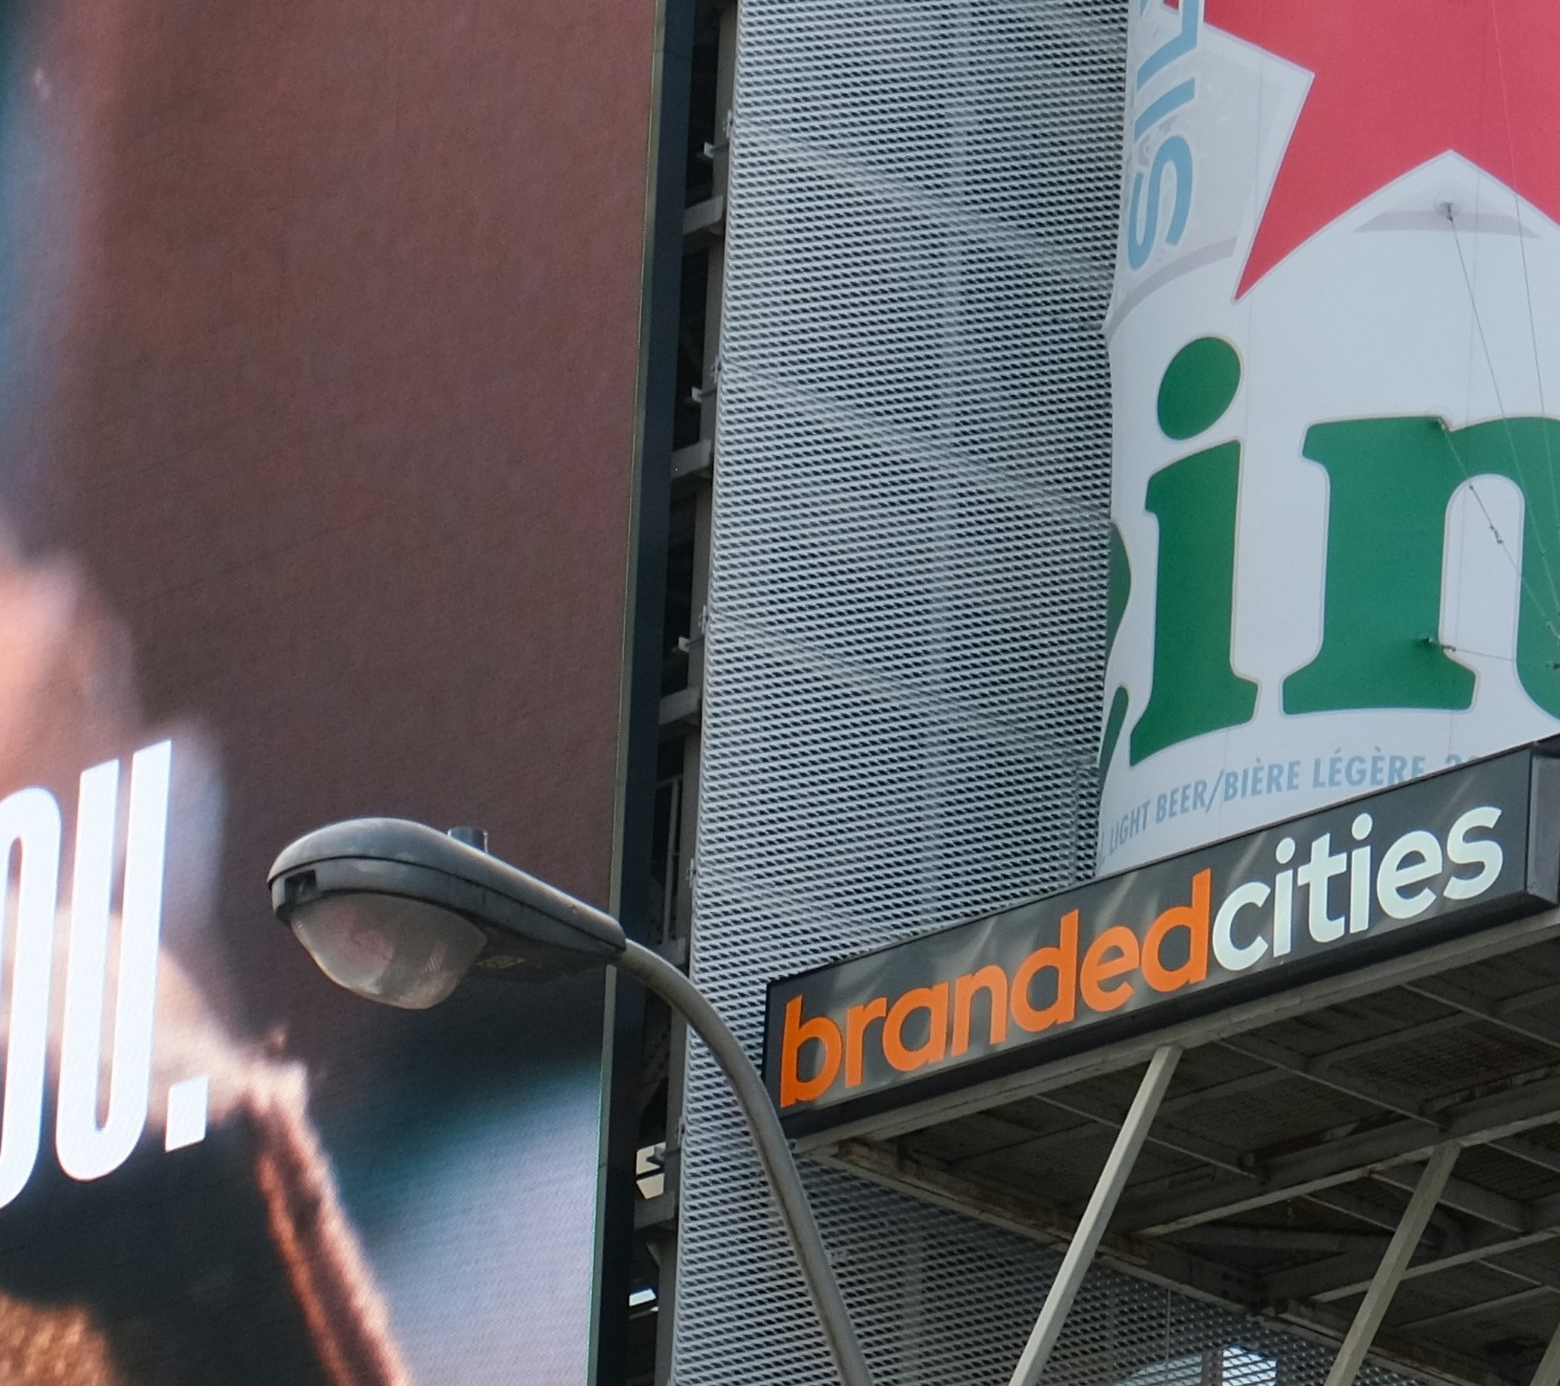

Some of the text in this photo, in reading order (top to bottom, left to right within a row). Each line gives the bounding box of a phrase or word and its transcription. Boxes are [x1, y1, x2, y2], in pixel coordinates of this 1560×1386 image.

[1109, 798, 1152, 856] LIGHT
[1154, 757, 1301, 824] BEER/BIÈRE
[1311, 745, 1427, 789] LÉGÈRE
